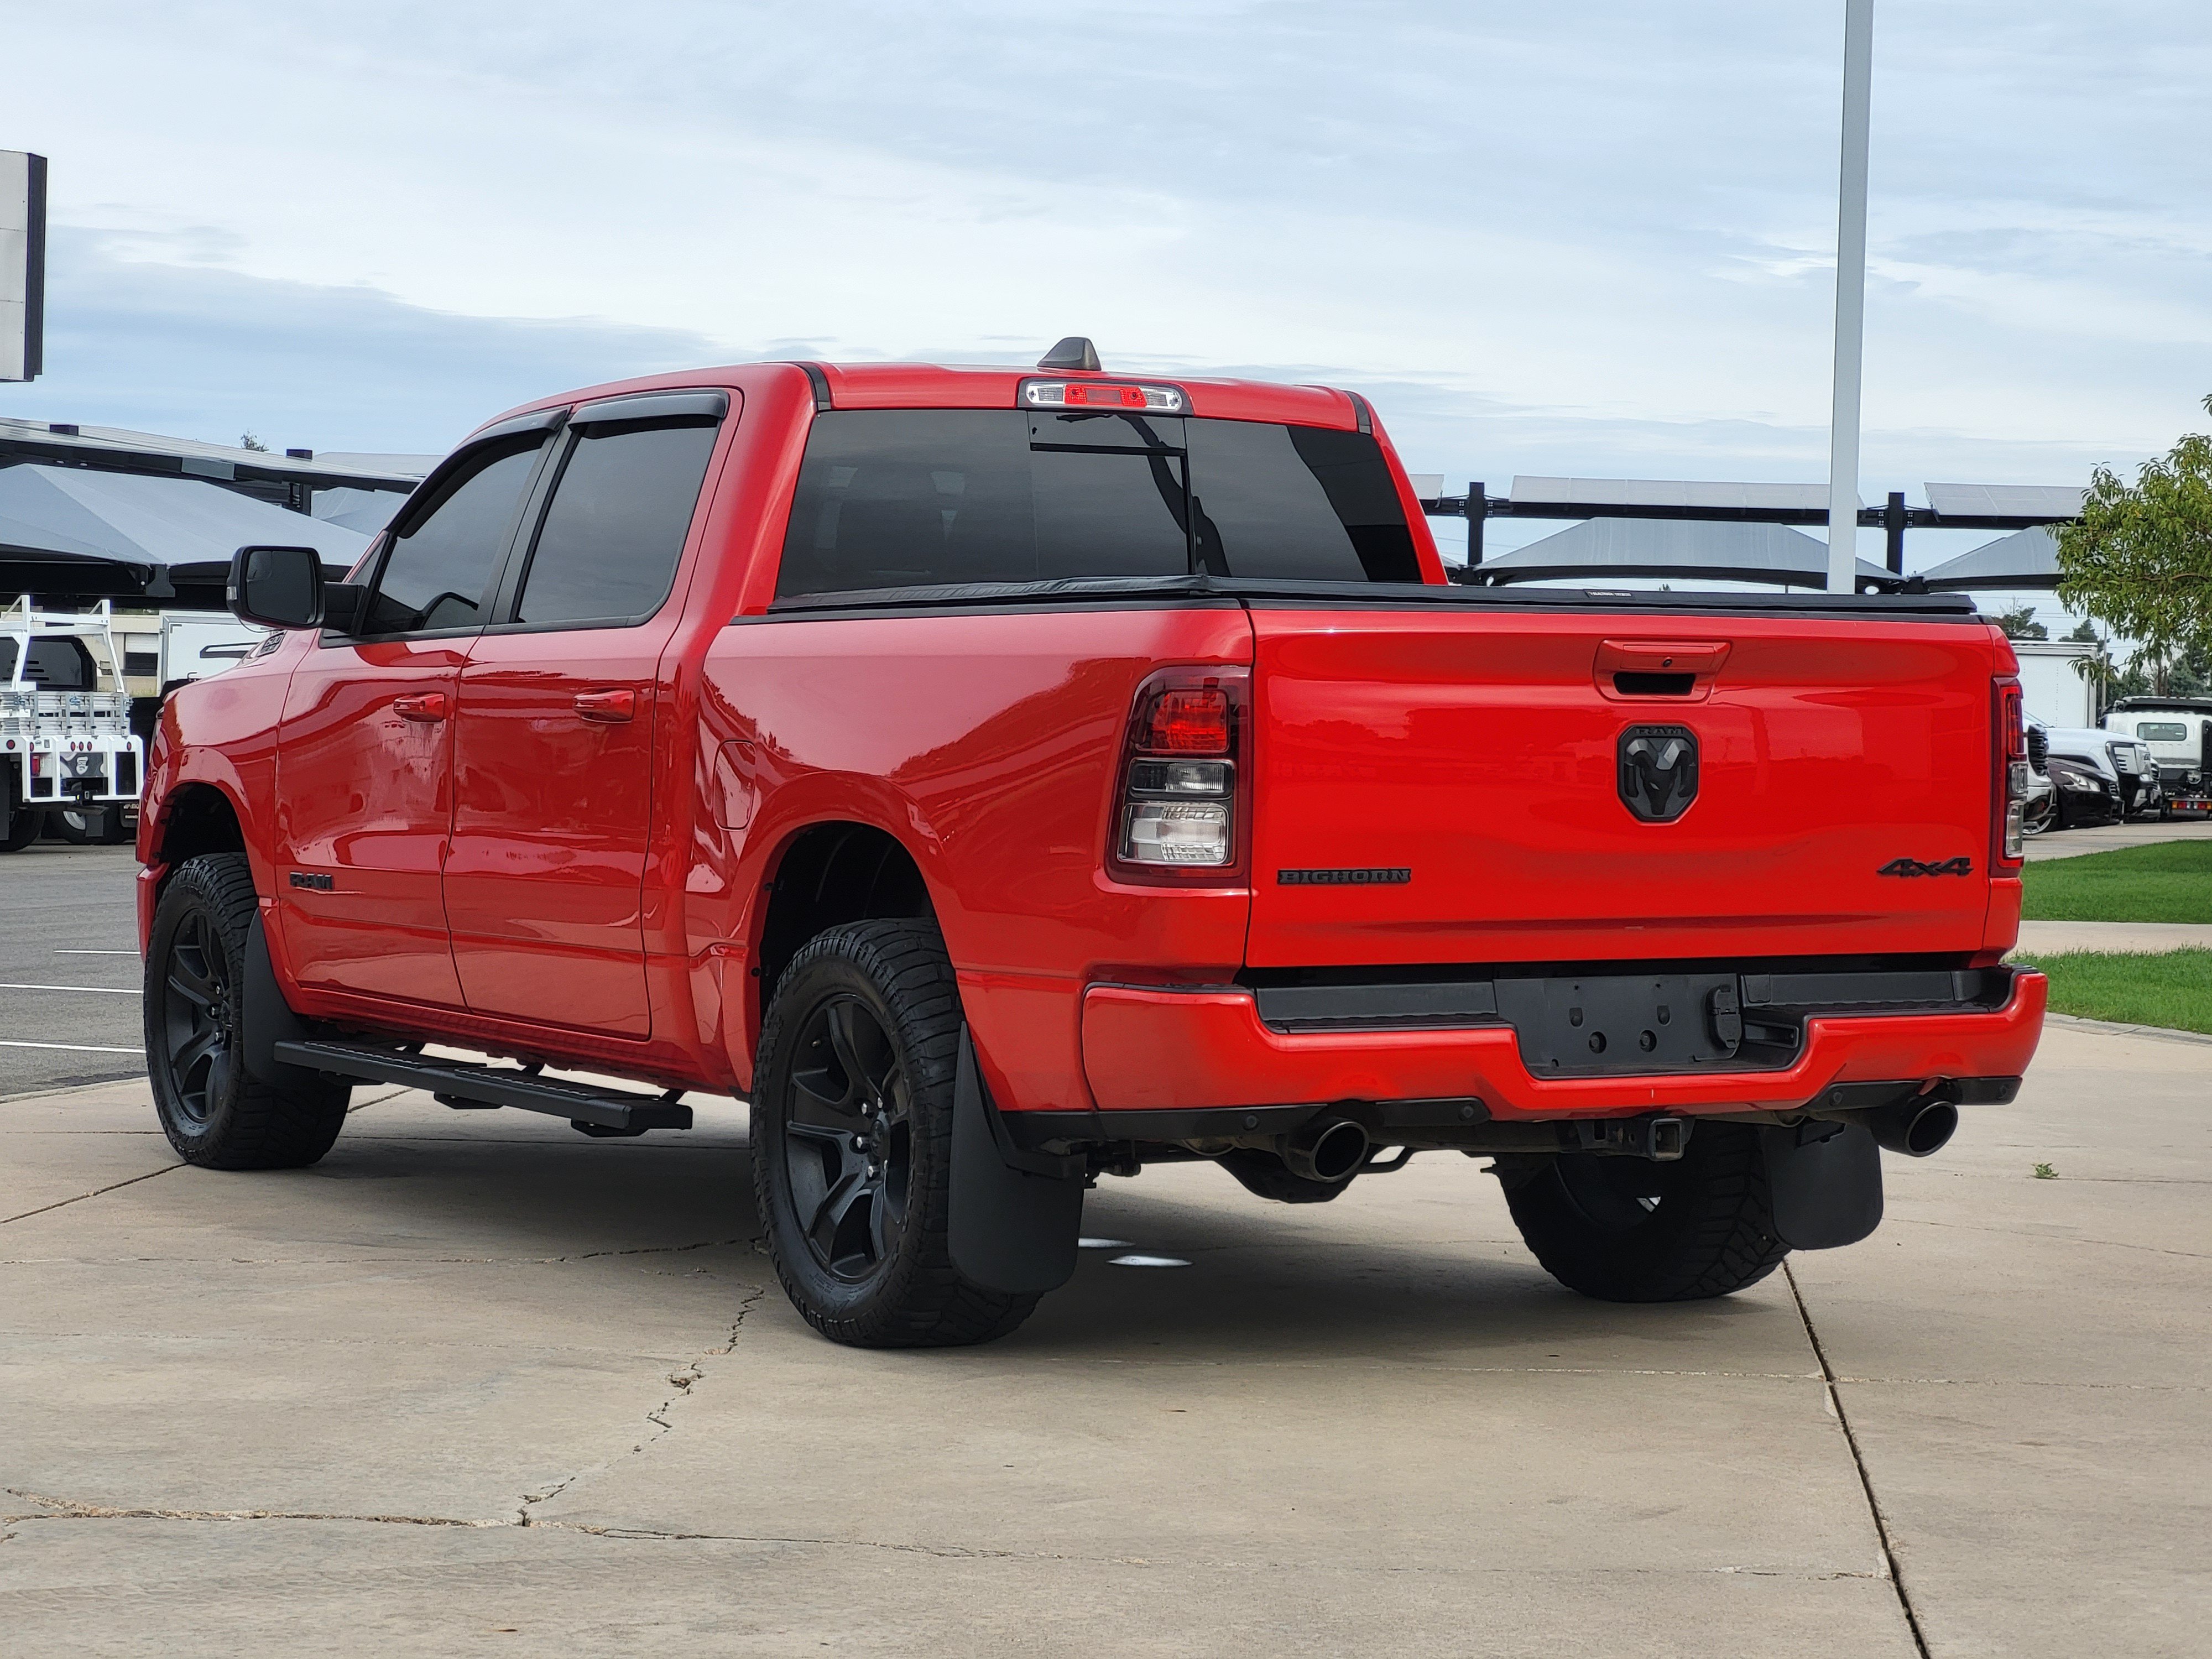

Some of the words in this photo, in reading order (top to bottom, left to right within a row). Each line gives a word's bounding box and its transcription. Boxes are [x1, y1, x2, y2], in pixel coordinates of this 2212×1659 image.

[1876, 857, 1974, 877] 4x4
[290, 872, 333, 890] RAM
[1277, 869, 1411, 884] BIGHORN
